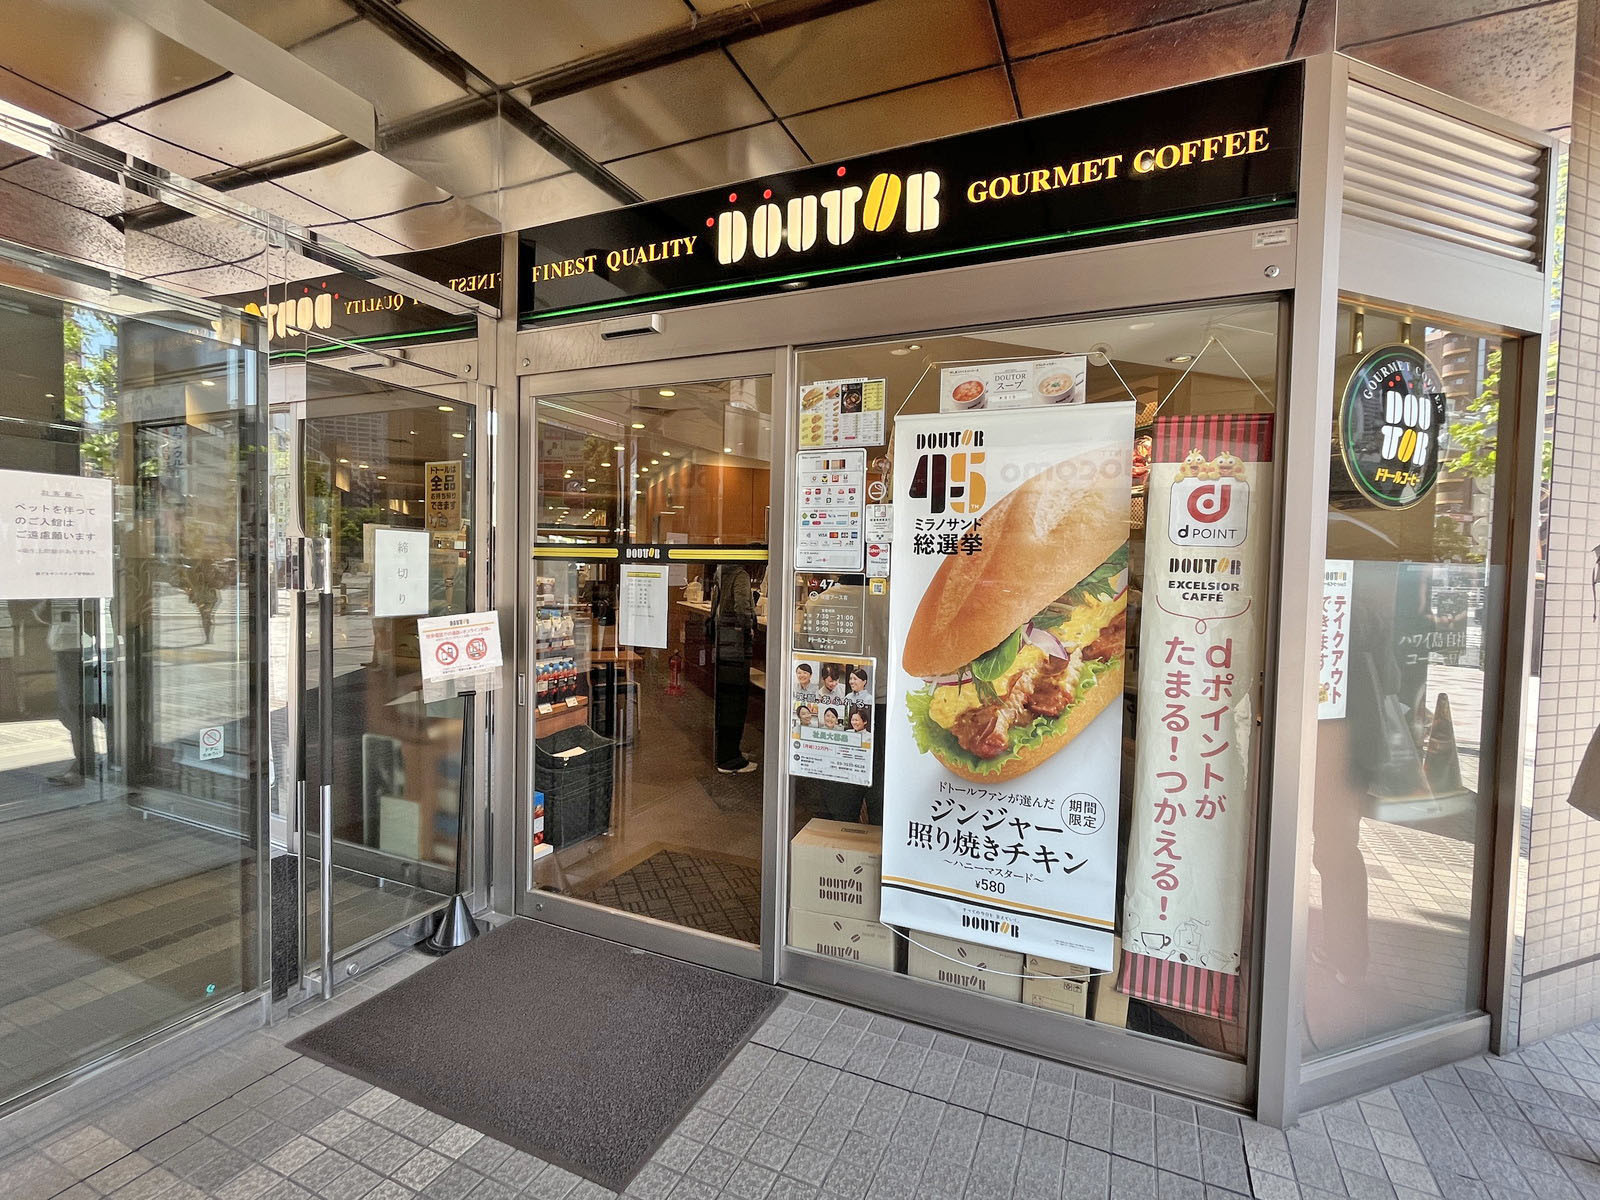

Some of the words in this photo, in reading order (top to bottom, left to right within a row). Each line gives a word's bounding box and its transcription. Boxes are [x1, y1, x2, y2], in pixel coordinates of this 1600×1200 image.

[967, 155, 1123, 204] GOURMET
[1133, 127, 1270, 173] COFFEE
[717, 170, 941, 265] DOUTOR
[532, 255, 597, 283] FINEST
[606, 235, 698, 271] QUALITY
[994, 372, 1026, 382] DOUTOR
[997, 380, 1024, 391] スープ
[1363, 360, 1411, 400] GOURMET
[916, 429, 984, 450] DOUTOR
[430, 475, 456, 491] 全品
[1375, 468, 1420, 487] ドトールコーヒー
[430, 501, 456, 510] できます
[914, 518, 983, 531] ミラノサンド
[1178, 525, 1189, 539] d
[1192, 529, 1238, 540] POINT
[626, 547, 660, 559] DOUTOR
[913, 533, 983, 556] 総選挙
[1169, 557, 1242, 576] DOUTOR
[1324, 571, 1347, 581] OUTOR
[1168, 580, 1240, 592] EXCELSIOR
[1182, 592, 1224, 603] CAFFÉ
[1331, 595, 1346, 704] テイクアウト
[1195, 637, 1235, 820] dポイントが
[938, 781, 1055, 810] ドトールファンが選んだ
[1068, 799, 1097, 815] 期間
[930, 798, 1064, 841] ジンジャー
[1068, 814, 1097, 830] 限定
[906, 820, 1089, 874] 照り焼きチキン
[819, 876, 863, 892] DOUTOR
[975, 879, 1005, 894] ¥580
[819, 888, 863, 905] DOUTOR
[961, 915, 1020, 939] DOUTOR
[816, 943, 860, 960] DOUTOR
[938, 969, 986, 991] DOUTOR
